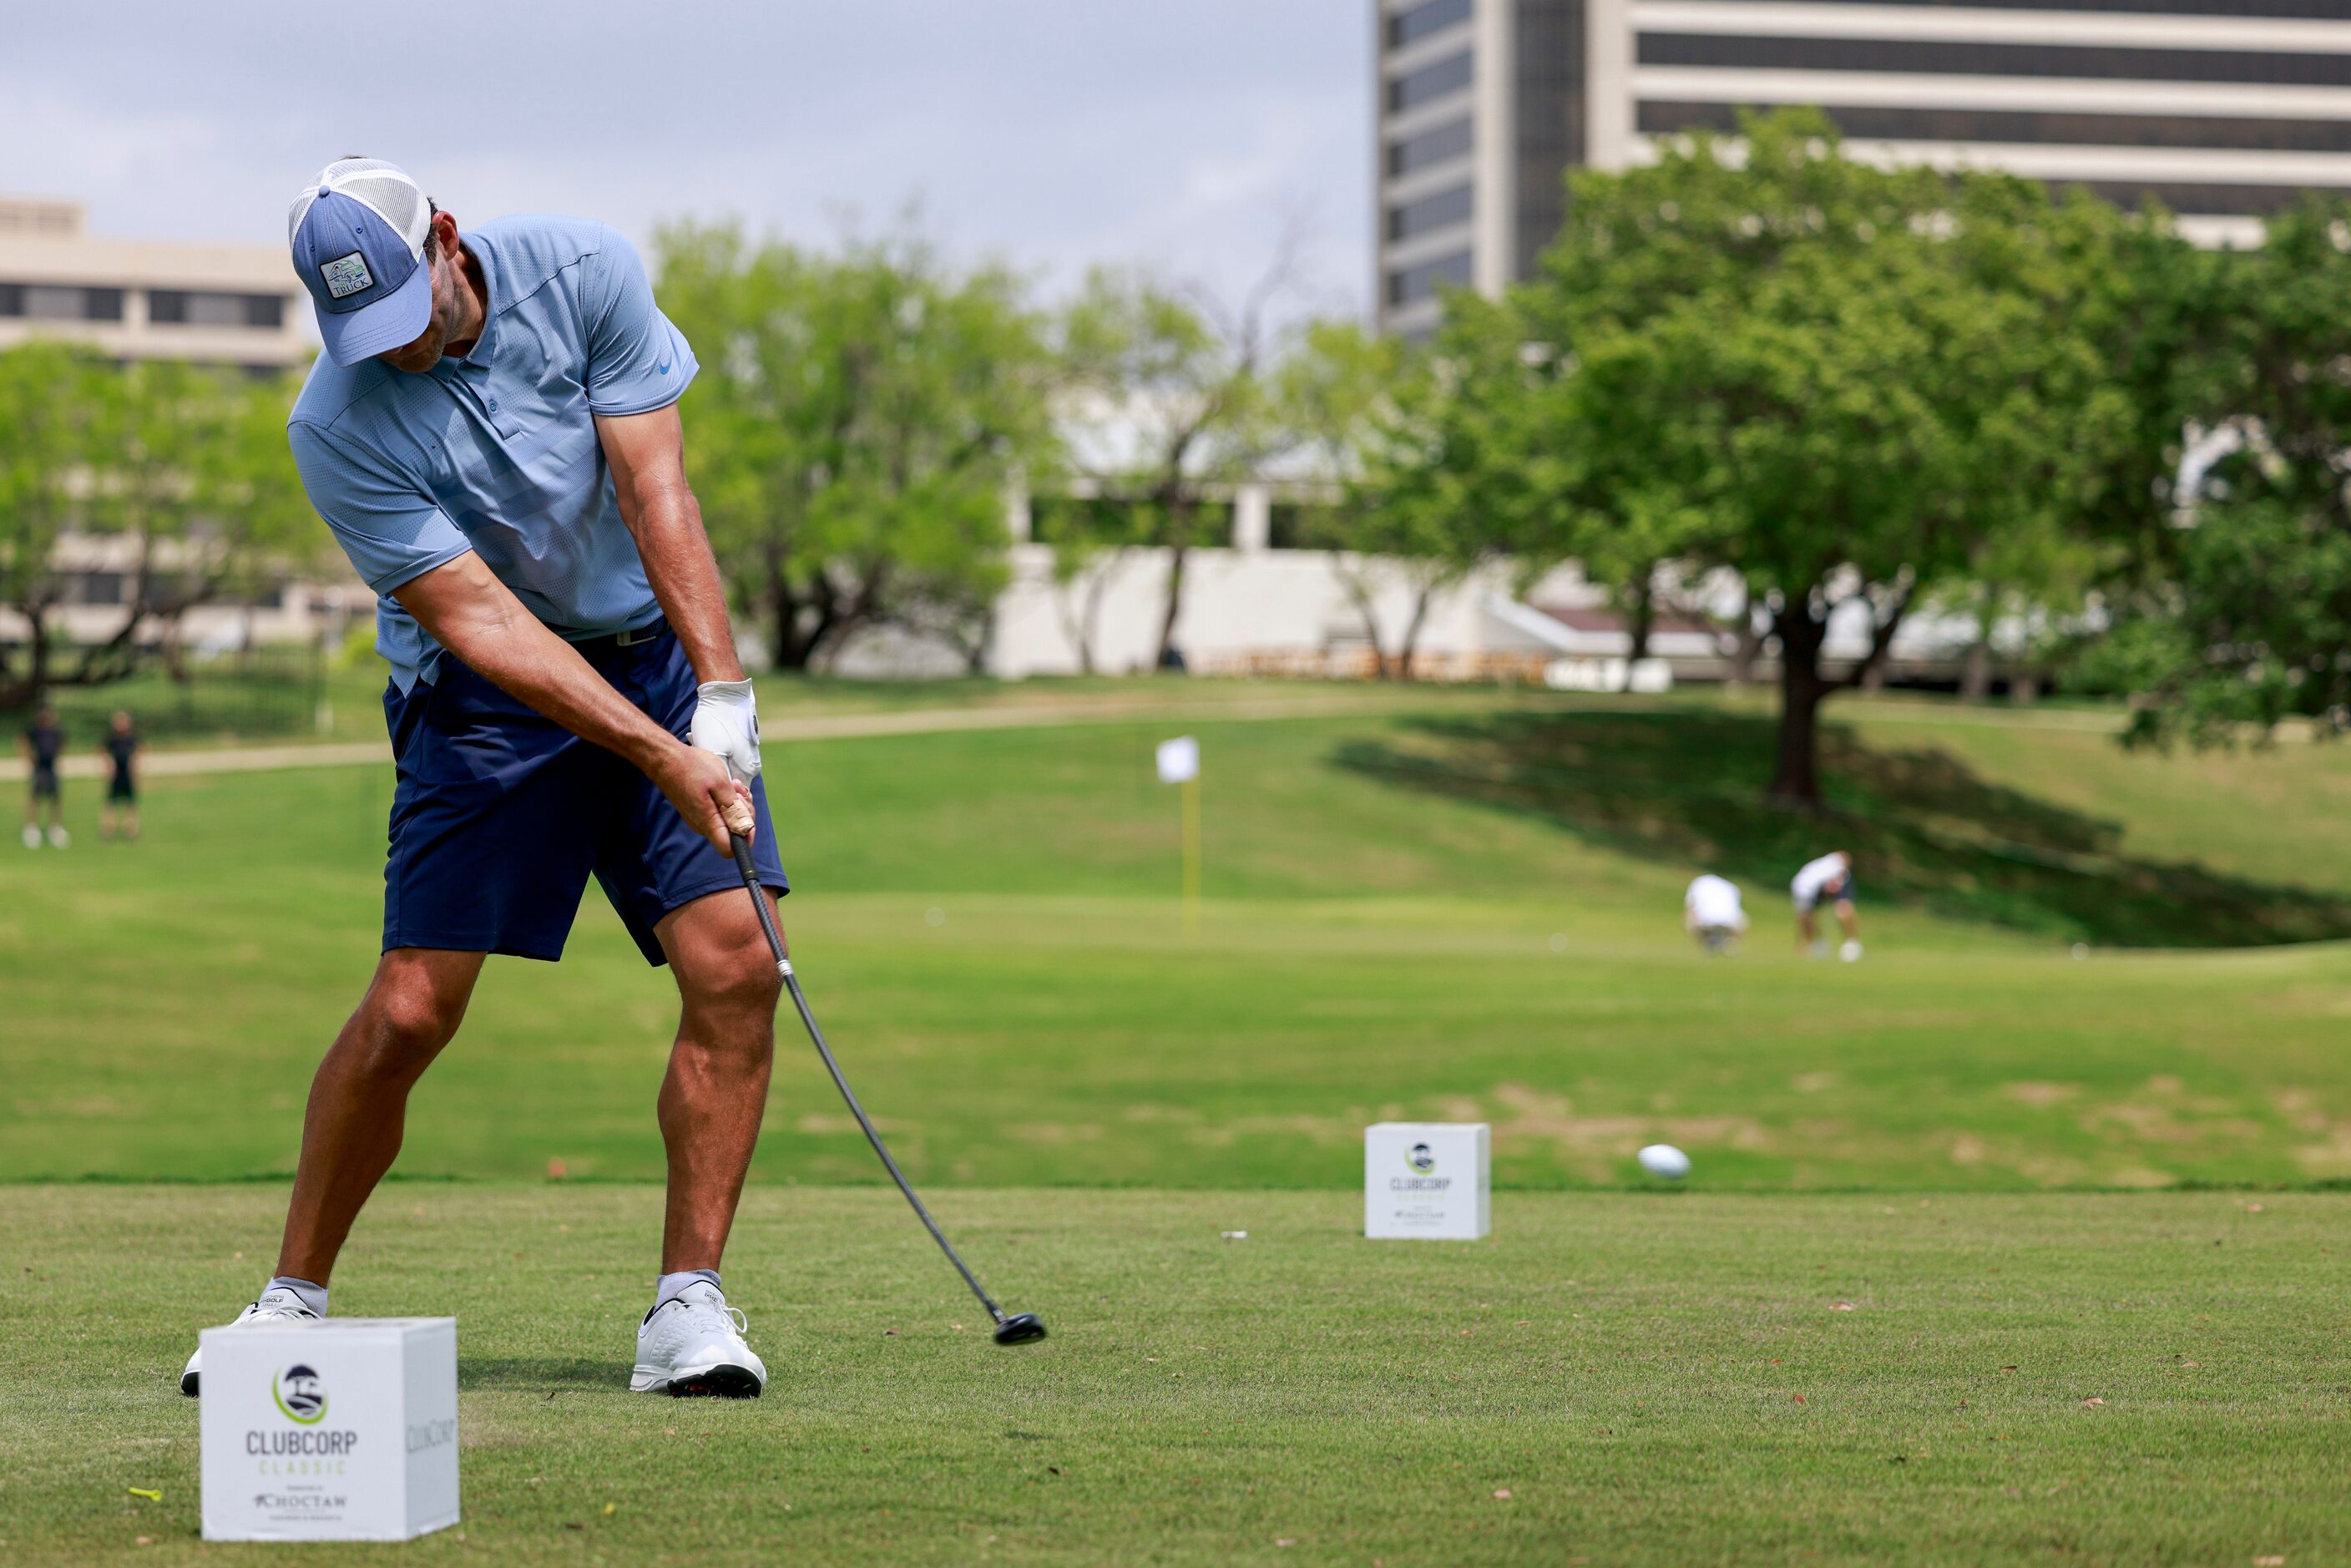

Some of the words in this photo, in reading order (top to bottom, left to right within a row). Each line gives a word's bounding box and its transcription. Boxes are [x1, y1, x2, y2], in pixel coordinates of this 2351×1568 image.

[334, 278, 368, 295] TRUCK
[246, 1430, 357, 1455] CLUBCORP
[258, 1459, 346, 1475] CLASSIC
[265, 1493, 347, 1507] CHOCTAW
